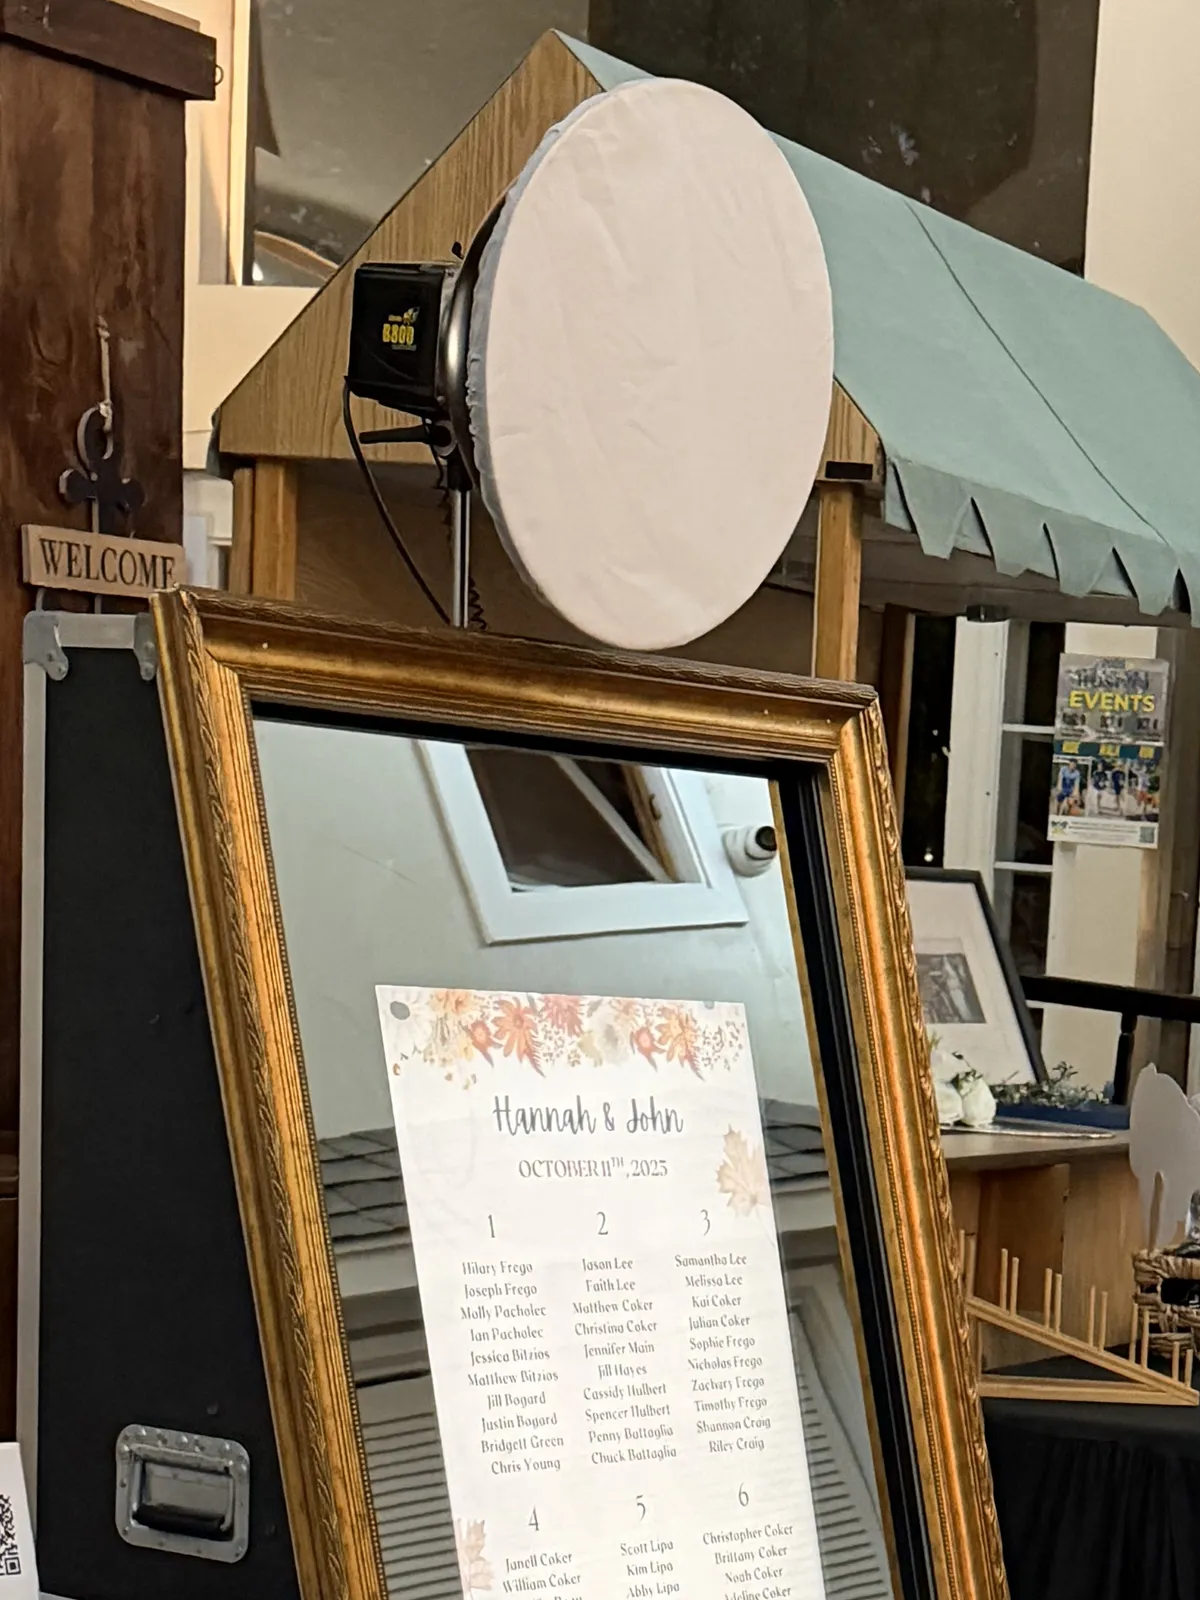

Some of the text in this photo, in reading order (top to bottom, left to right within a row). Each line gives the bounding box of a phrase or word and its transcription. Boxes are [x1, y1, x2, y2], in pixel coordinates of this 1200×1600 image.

[1069, 690, 1154, 712] EVENTS
[493, 1095, 683, 1136] Hannah & John
[519, 1160, 598, 1177] OCTOBER
[632, 1160, 668, 1177] 2025
[488, 1215, 495, 1237] 1
[597, 1212, 608, 1235] 2
[701, 1209, 710, 1236] 3
[582, 1257, 633, 1271] Jason Lee
[675, 1253, 747, 1267] Samantha Lee
[462, 1261, 533, 1276] Hilary Frego
[586, 1279, 636, 1292] Faith Lee
[685, 1274, 743, 1288] Melissa Lee
[465, 1284, 537, 1299] Joseph Frego
[573, 1299, 653, 1314] Matthew Coker
[712, 1295, 742, 1307] Coker
[460, 1306, 492, 1321] Molly
[575, 1321, 657, 1336] Christina Coker
[689, 1314, 750, 1331] Julian Coker
[471, 1329, 489, 1342] Ian
[689, 1335, 756, 1351] Sophie Frego
[584, 1341, 655, 1359] Jennifer Main
[471, 1351, 510, 1366] Jessica
[688, 1356, 763, 1371] Nicholas Frego
[468, 1373, 517, 1386] Matthew
[598, 1364, 647, 1379] Jill Hayes
[583, 1383, 666, 1400] Cassidy Hulbert
[736, 1376, 765, 1391] Frego
[487, 1392, 546, 1409] Jill Bogard
[695, 1396, 767, 1412] Timothy Frego
[585, 1404, 671, 1424] Spencer Hulbert
[482, 1413, 558, 1433] Justin Bogard
[696, 1416, 771, 1434] Shannon Craig
[589, 1425, 674, 1443] Penny Battaglia
[531, 1436, 564, 1449] Green
[709, 1436, 765, 1453] Riley Craig
[592, 1445, 677, 1464] Chuck Battaglia
[492, 1458, 561, 1475] Chris Young
[739, 1482, 749, 1506] 6
[636, 1495, 646, 1521] 5
[528, 1505, 539, 1531] 4
[764, 1524, 793, 1539] Coker
[540, 1552, 573, 1567] Coker
[759, 1546, 788, 1560] Coker
[754, 1567, 783, 1581] Coker
[503, 1574, 581, 1594] William Coker
[763, 1587, 791, 1600] Coker
